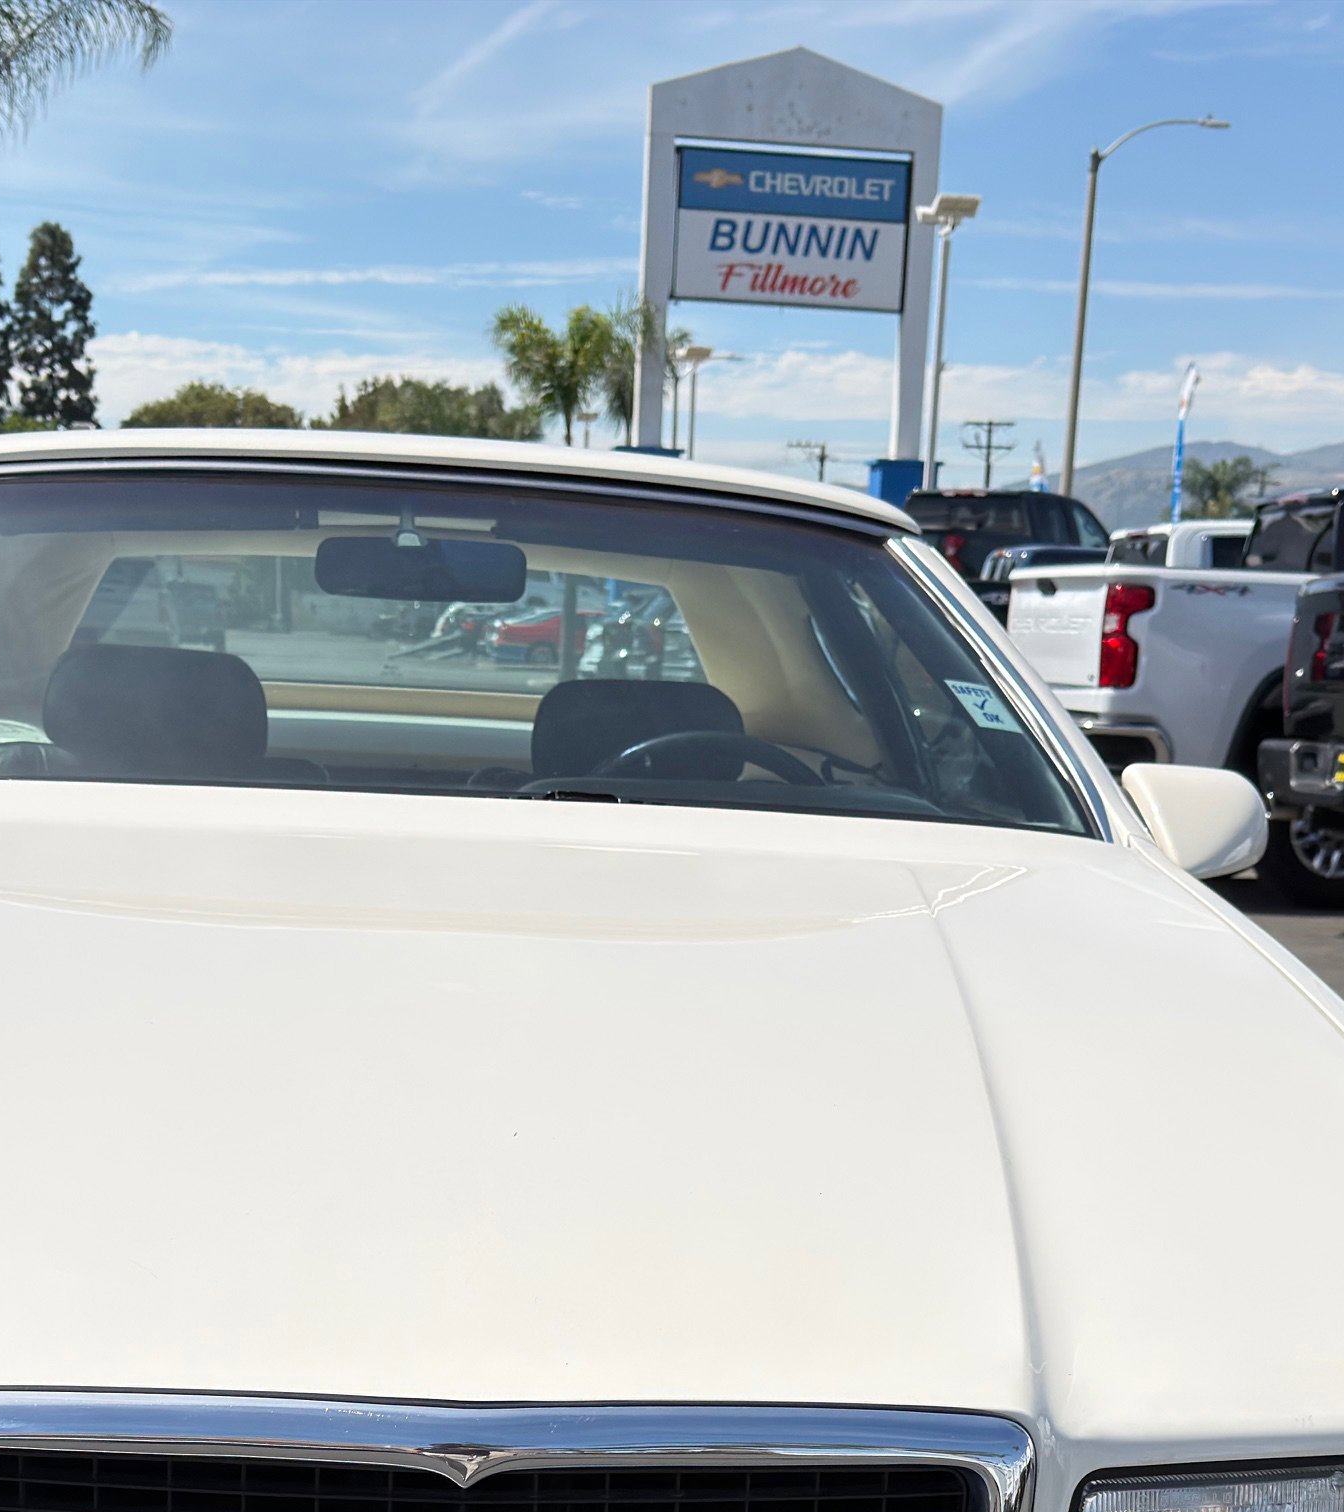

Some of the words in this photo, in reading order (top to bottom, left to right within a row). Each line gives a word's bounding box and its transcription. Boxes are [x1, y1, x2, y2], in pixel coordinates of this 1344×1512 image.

[748, 169, 896, 201] CHEVROLET
[708, 218, 880, 261] BUNNIN
[717, 262, 861, 299] Fillmore
